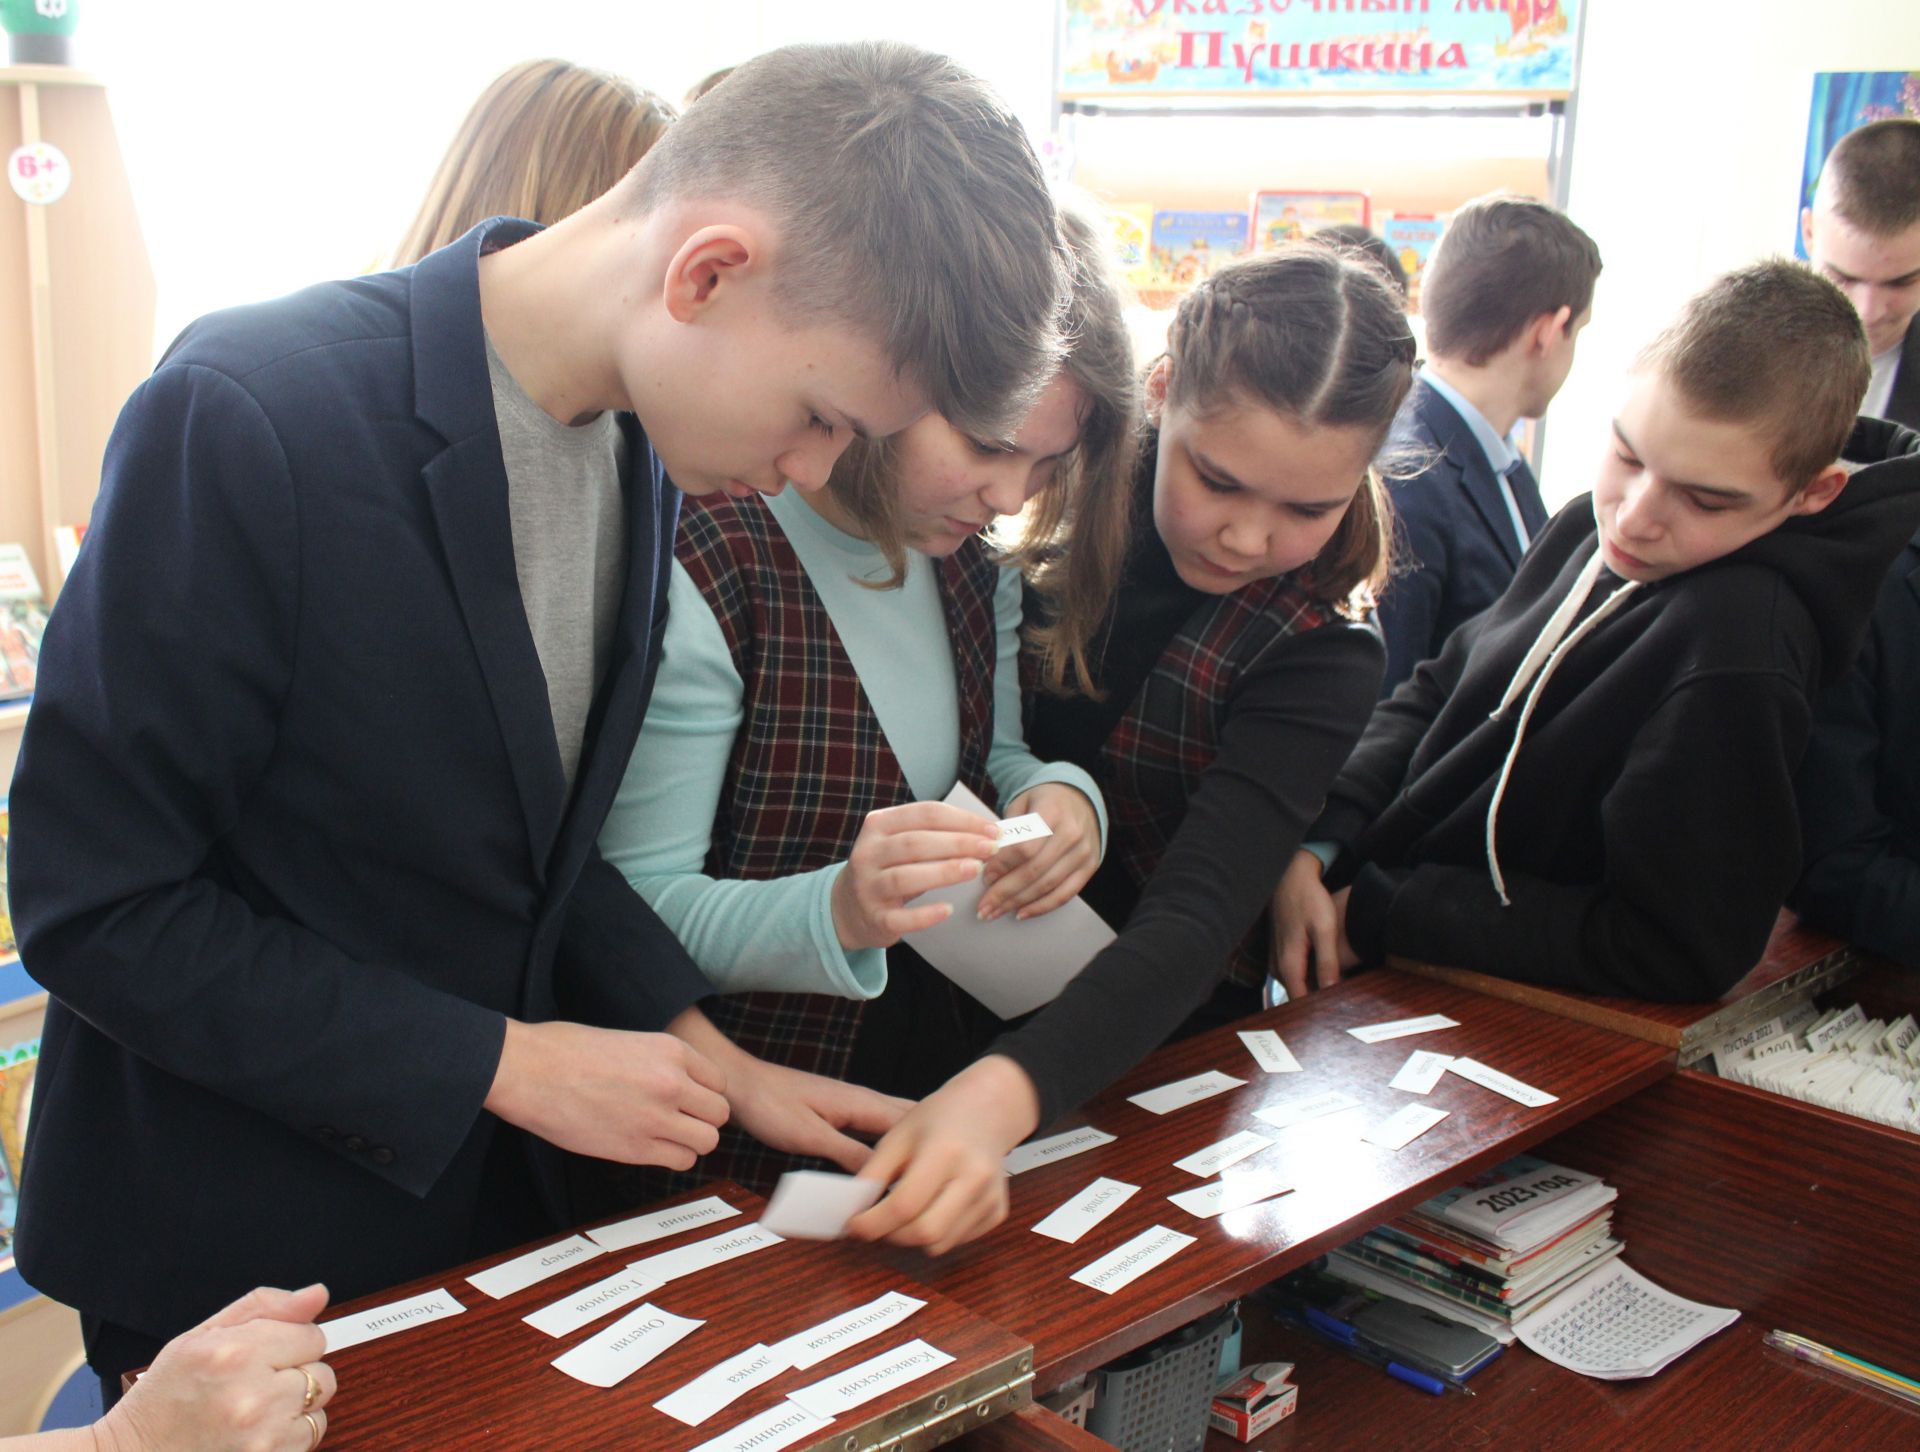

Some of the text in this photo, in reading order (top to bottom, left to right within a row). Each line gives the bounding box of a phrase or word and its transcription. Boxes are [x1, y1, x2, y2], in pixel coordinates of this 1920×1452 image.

[1175, 30, 1469, 83] Пушкина
[16, 155, 59, 178] 6+
[1083, 1188, 1122, 1214] Скупой
[1476, 1175, 1582, 1213] 2023 год
[657, 1207, 721, 1230] Зимний
[541, 1246, 583, 1268] вечер
[713, 1233, 763, 1255] Борис
[1089, 1231, 1181, 1288] Бахчисарайский
[576, 1278, 643, 1313] Годунов
[366, 1301, 445, 1331] Медный
[807, 1300, 909, 1351] Капитанская
[610, 1317, 665, 1352] Онегин
[727, 1355, 772, 1384] дочка
[838, 1351, 936, 1398] Кавказский
[735, 1412, 806, 1452] пленник
